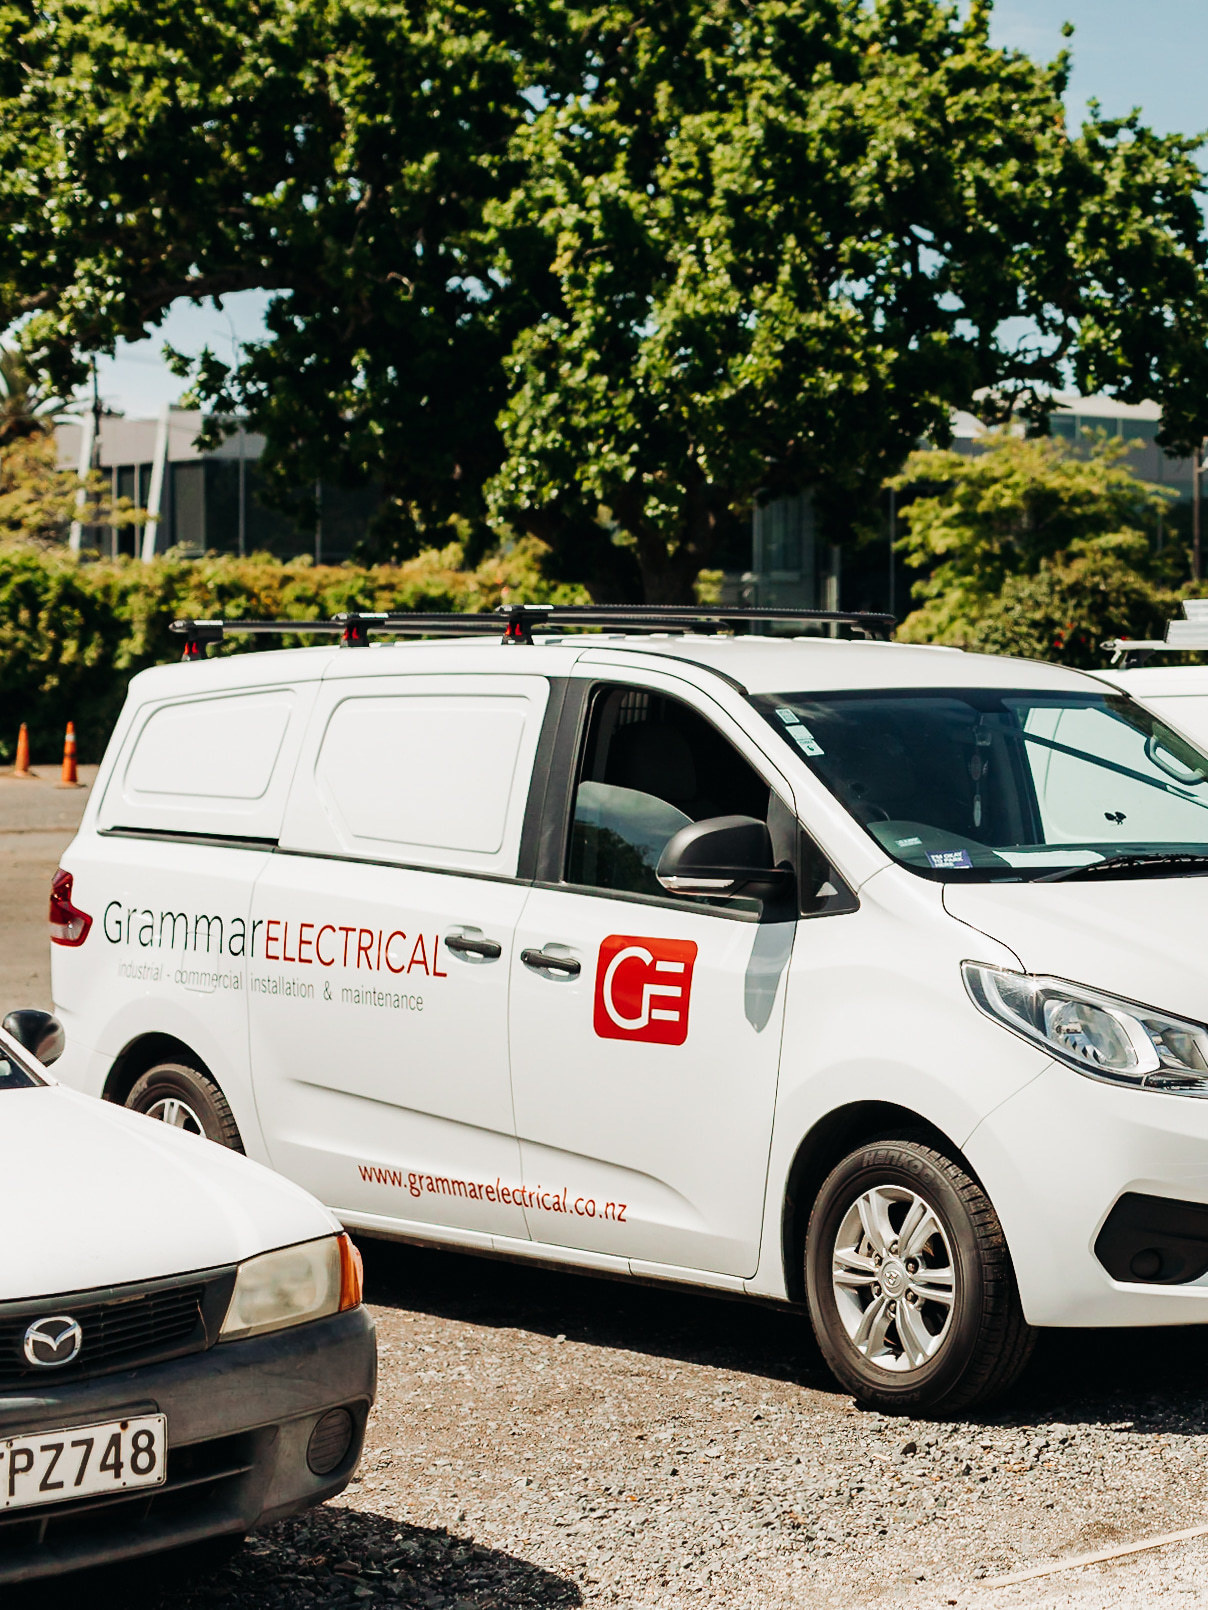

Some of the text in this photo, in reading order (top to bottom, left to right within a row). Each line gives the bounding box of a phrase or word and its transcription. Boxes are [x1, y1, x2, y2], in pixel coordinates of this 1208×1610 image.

[103, 900, 448, 978] GrammarELECTRICAL
[118, 958, 164, 982] industrial
[174, 968, 243, 990] commercial
[250, 972, 315, 1000] installation
[322, 980, 333, 1001] &
[341, 984, 424, 1012] maintenance
[358, 1164, 627, 1222] www.grammarelectrical.co.nz
[0, 1429, 157, 1497] PZ748
